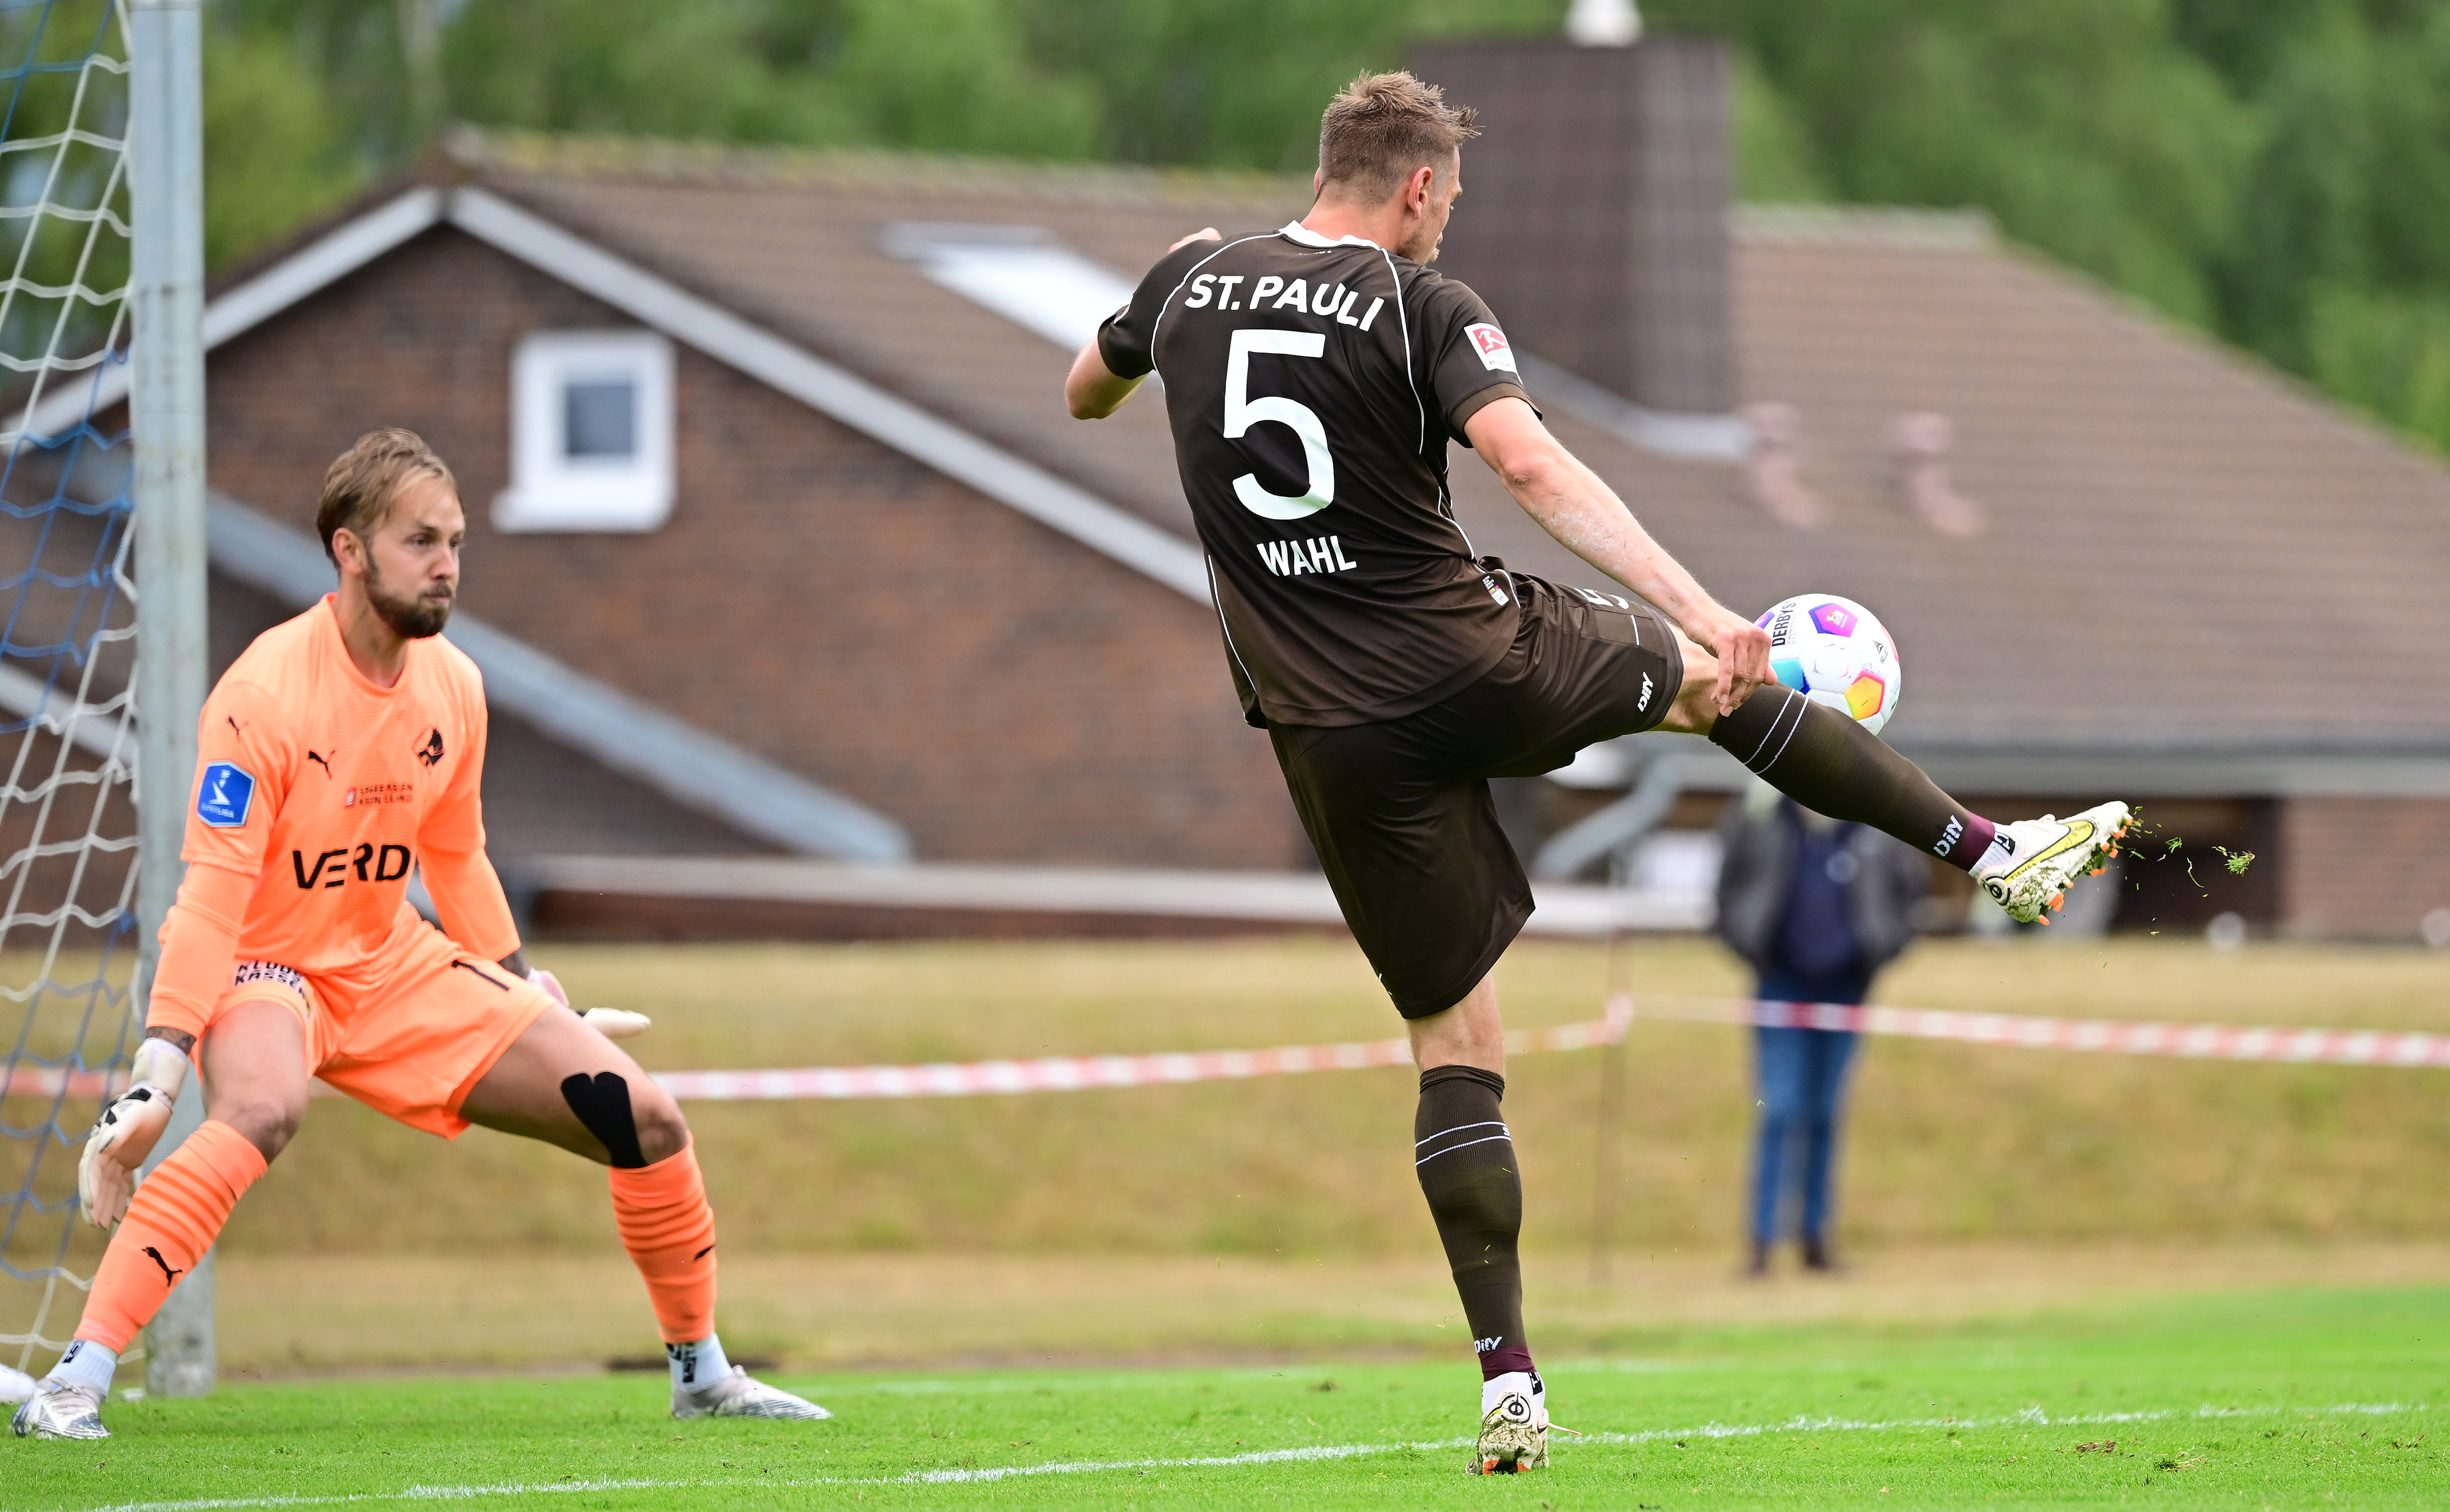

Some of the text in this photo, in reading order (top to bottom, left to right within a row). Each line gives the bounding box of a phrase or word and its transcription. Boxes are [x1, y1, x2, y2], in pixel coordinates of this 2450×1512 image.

[1184, 273, 1384, 332] ST. PAULI
[1223, 328, 1335, 520] 5
[1256, 535, 1357, 576] WAHL
[1771, 601, 1796, 647] DERBYS
